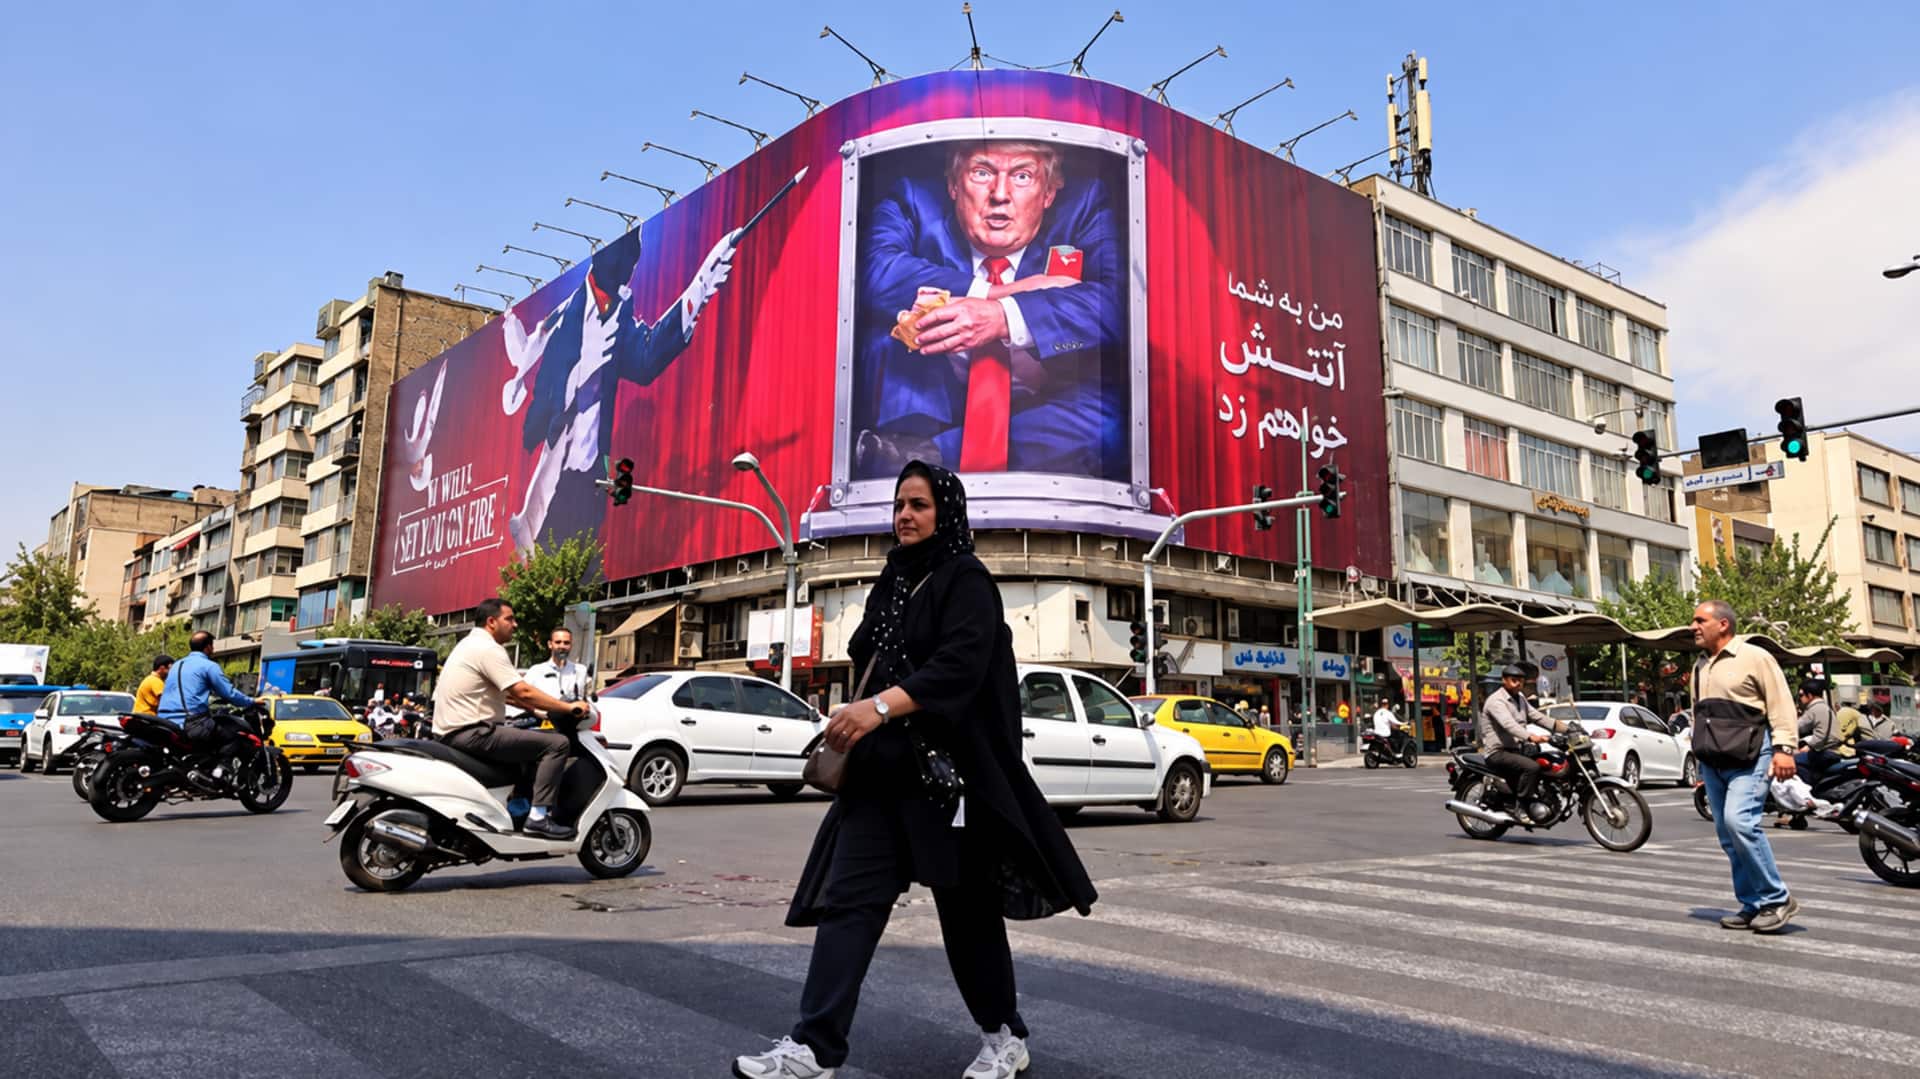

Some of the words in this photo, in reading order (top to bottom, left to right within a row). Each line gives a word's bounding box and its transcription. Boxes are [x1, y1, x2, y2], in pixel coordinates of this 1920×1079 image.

[1228, 271, 1275, 309] شما
[1278, 292, 1304, 326] به
[1308, 303, 1343, 332] من
[1218, 393, 1248, 439] زد
[1258, 406, 1348, 459] خواهم
[399, 521, 420, 563] SET
[419, 511, 446, 558] YOU
[446, 503, 467, 549] ON
[465, 492, 497, 545] FIRE
